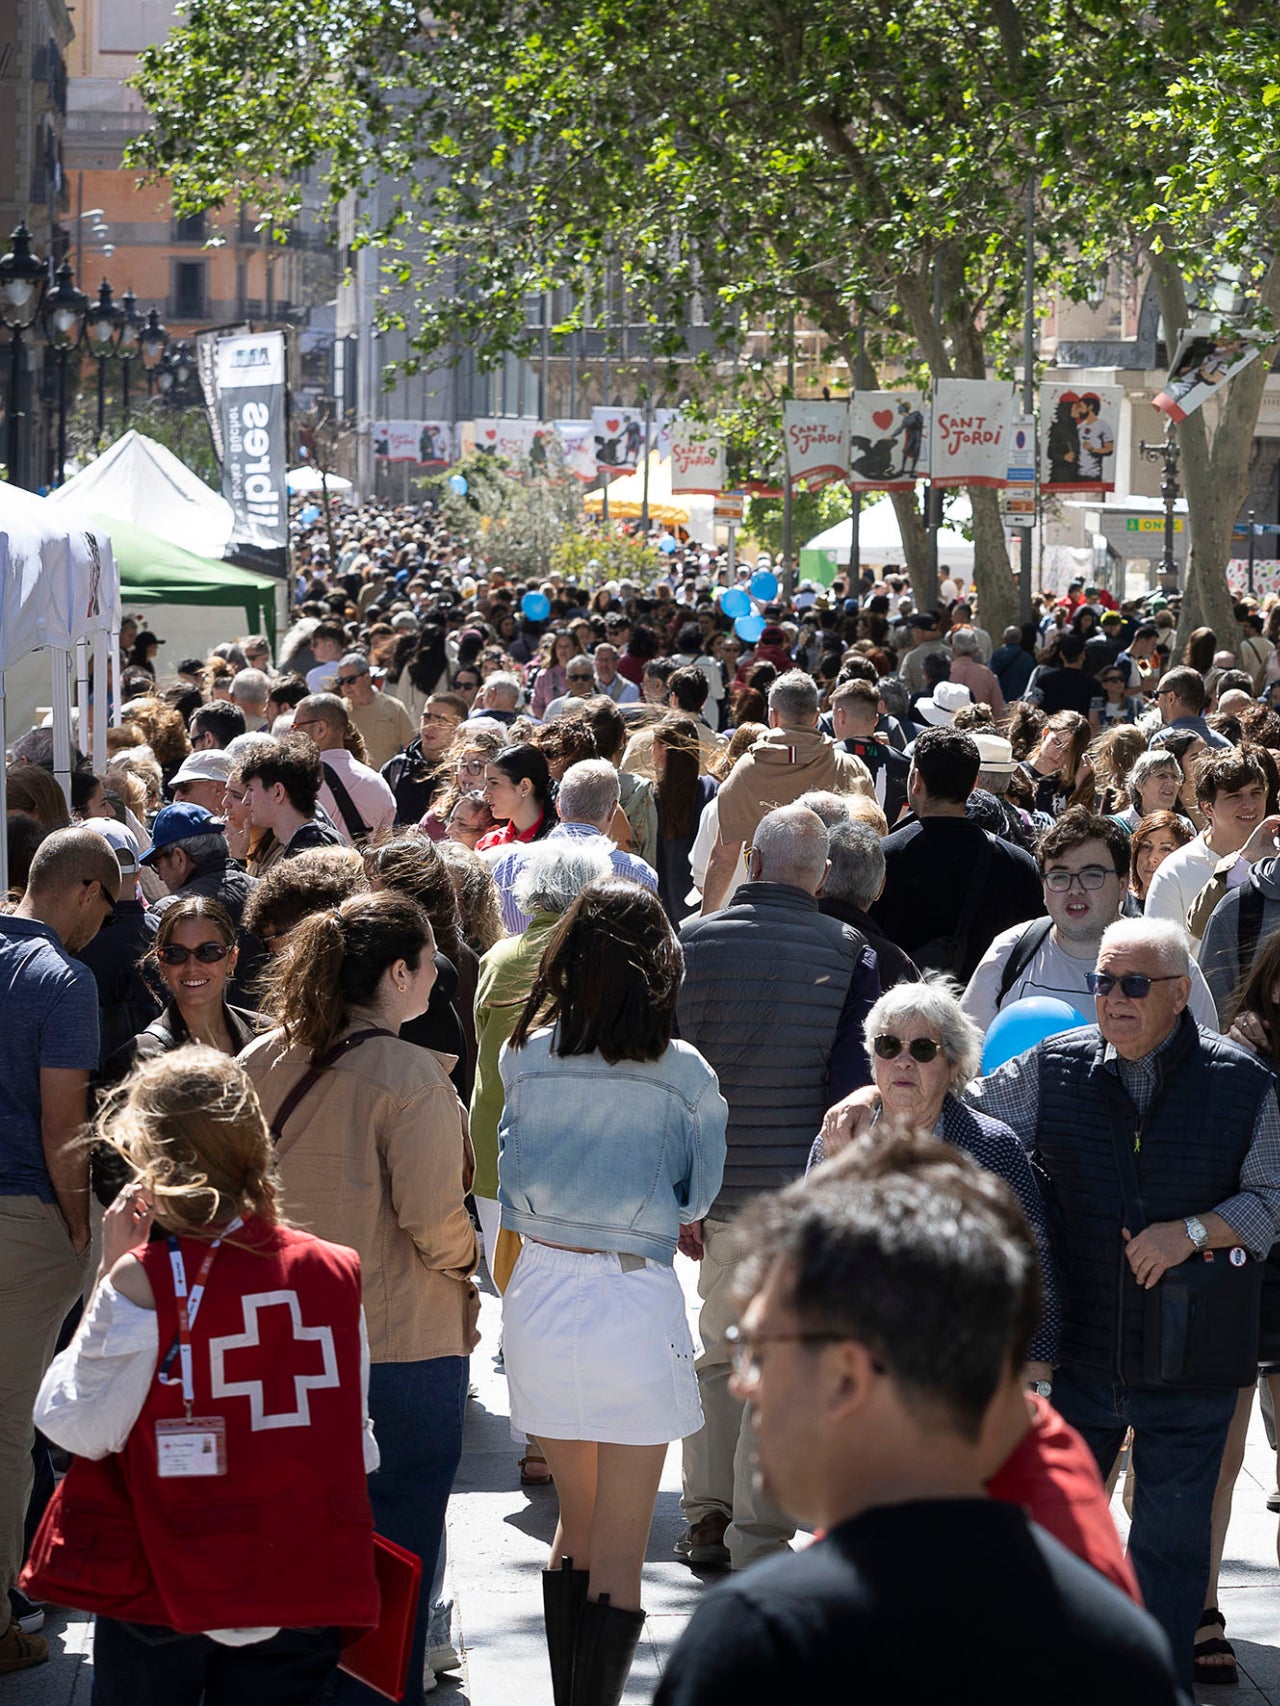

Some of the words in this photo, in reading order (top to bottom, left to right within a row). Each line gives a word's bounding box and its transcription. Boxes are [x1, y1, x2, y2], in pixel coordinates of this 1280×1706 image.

[789, 424, 828, 444] SANT
[938, 414, 986, 439] SANT
[672, 444, 705, 462] SANT
